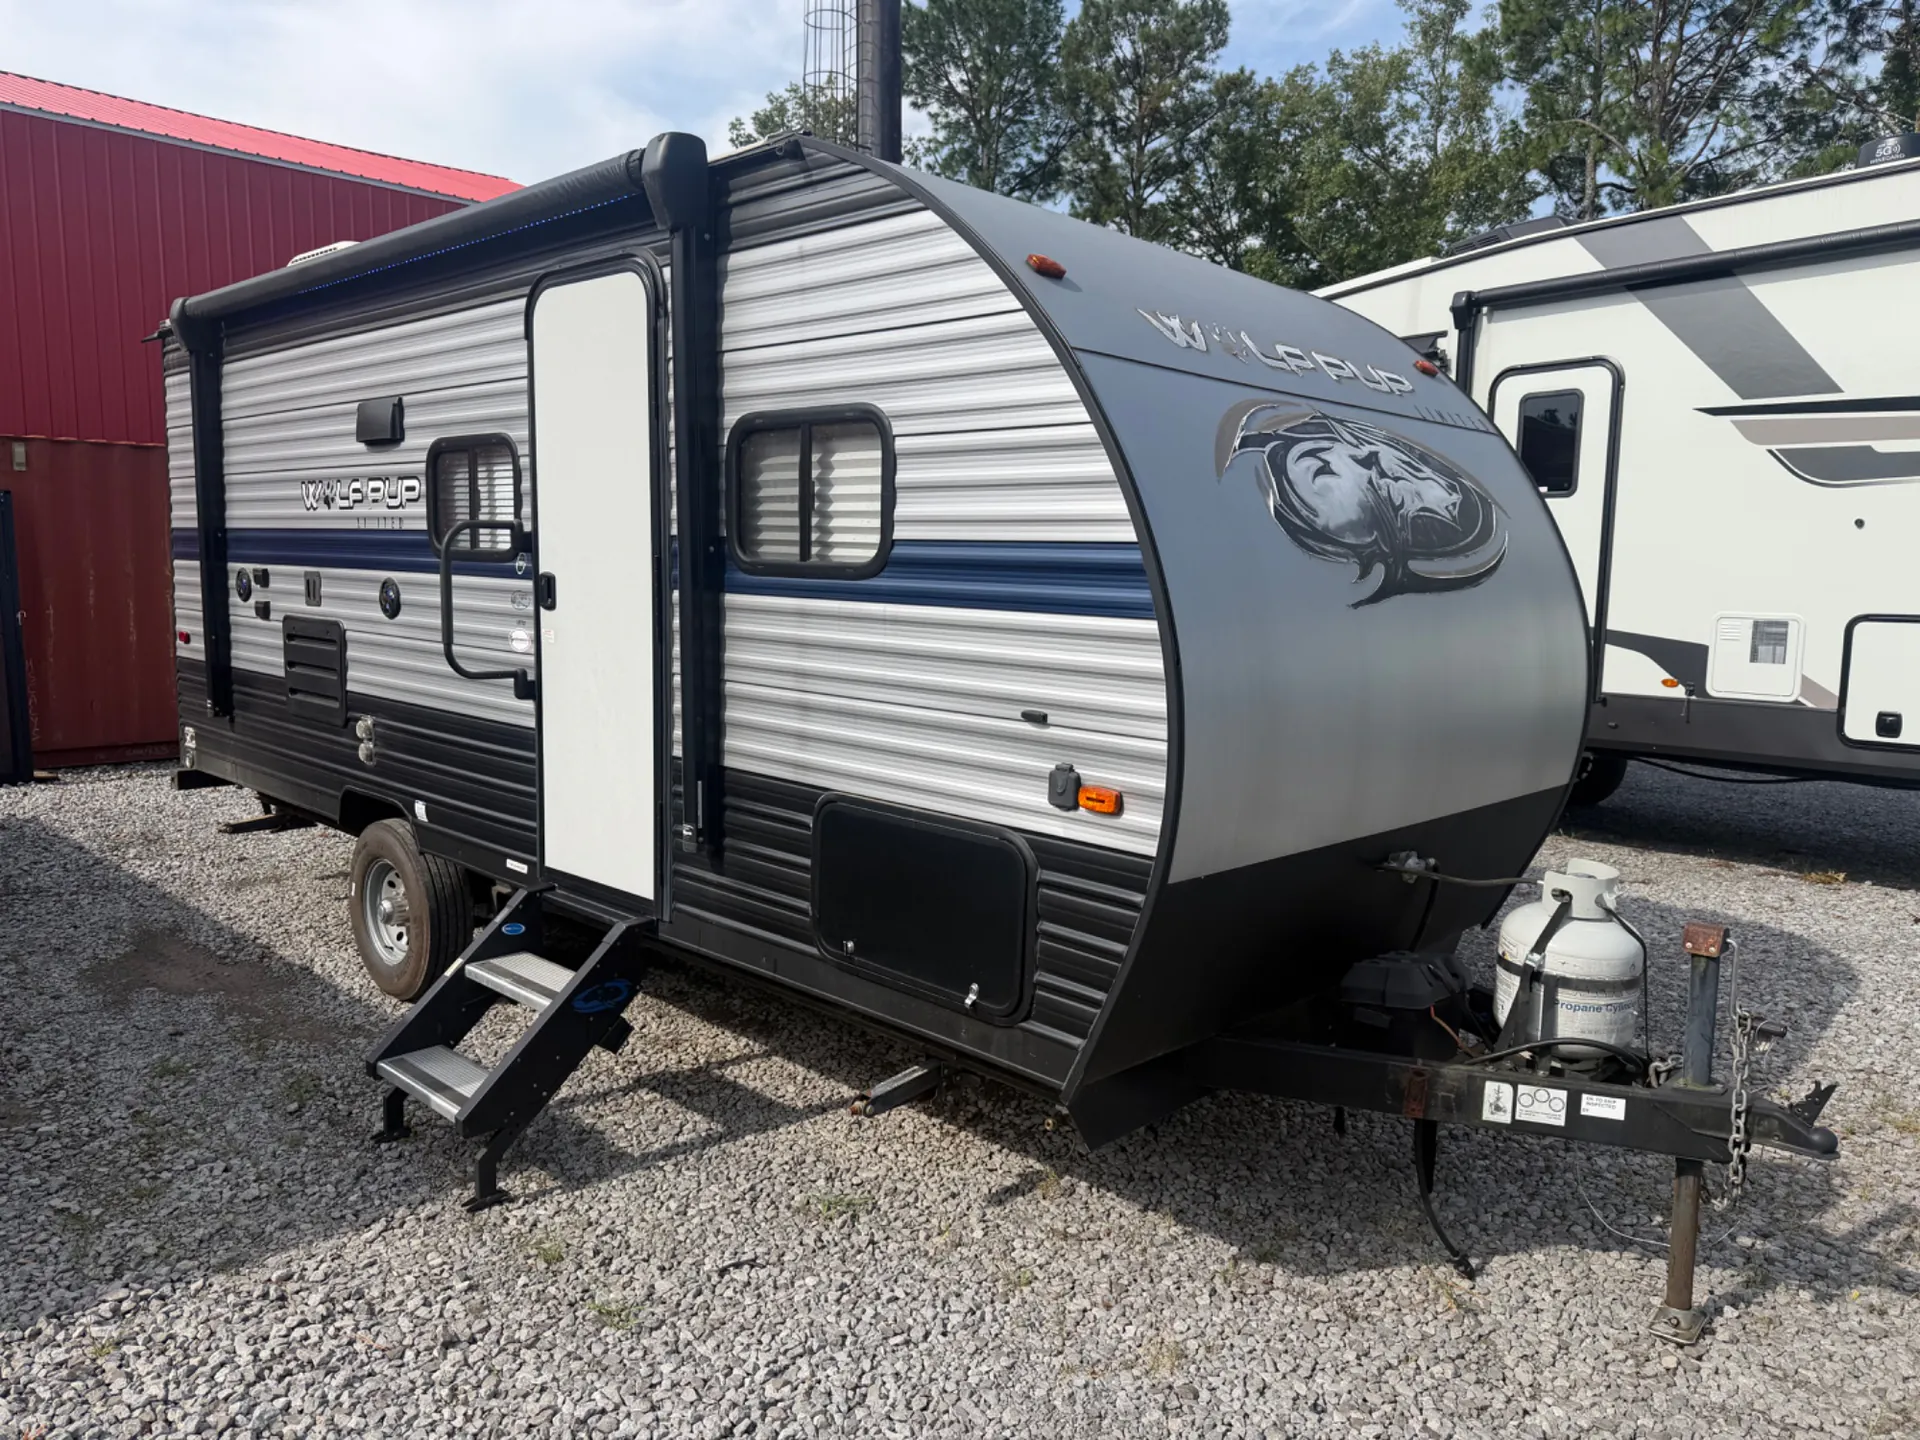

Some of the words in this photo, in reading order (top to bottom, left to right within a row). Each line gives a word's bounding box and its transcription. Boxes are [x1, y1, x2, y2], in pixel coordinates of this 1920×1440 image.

[1311, 350, 1416, 396] PUP
[366, 475, 421, 510] PUP
[356, 516, 404, 530] LIITED
[1556, 1000, 1602, 1013] ropane
